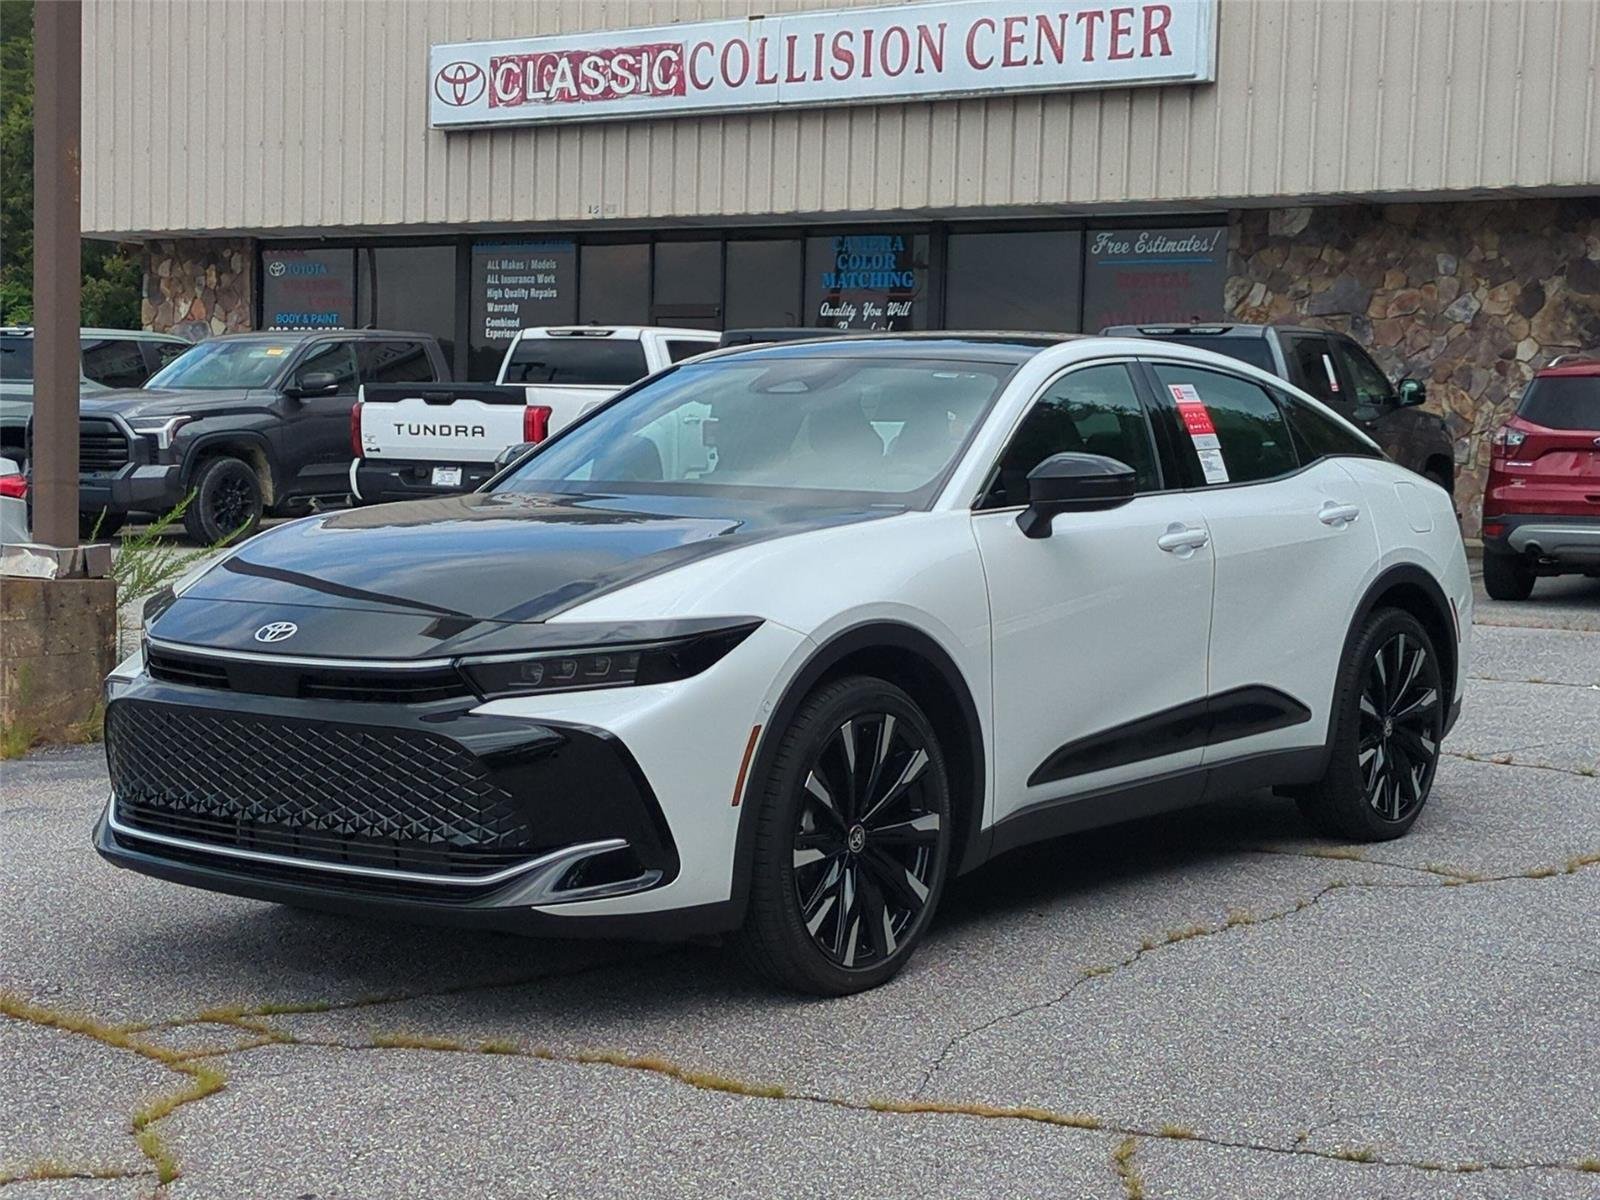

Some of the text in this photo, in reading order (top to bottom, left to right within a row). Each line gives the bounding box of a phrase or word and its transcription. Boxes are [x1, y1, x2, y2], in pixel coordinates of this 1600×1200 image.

[495, 4, 1173, 102] CLASSIC COLLISION CENTER
[1091, 231, 1221, 254] Free Estimates!
[487, 260, 500, 269] ALL
[501, 260, 524, 269] Makes
[531, 260, 557, 269] Models
[838, 254, 896, 269] COLOR
[288, 264, 327, 274] TOYOTA
[487, 274, 555, 284] ALL Insurance Work
[822, 272, 913, 288] MATCHING
[487, 288, 557, 299] High Quality Repairs
[487, 302, 519, 314] Warranty
[820, 301, 912, 322] Quality You Will
[276, 313, 338, 323] BODY & PAINT
[485, 317, 520, 327] Combined
[393, 423, 486, 437] TUNDRA
